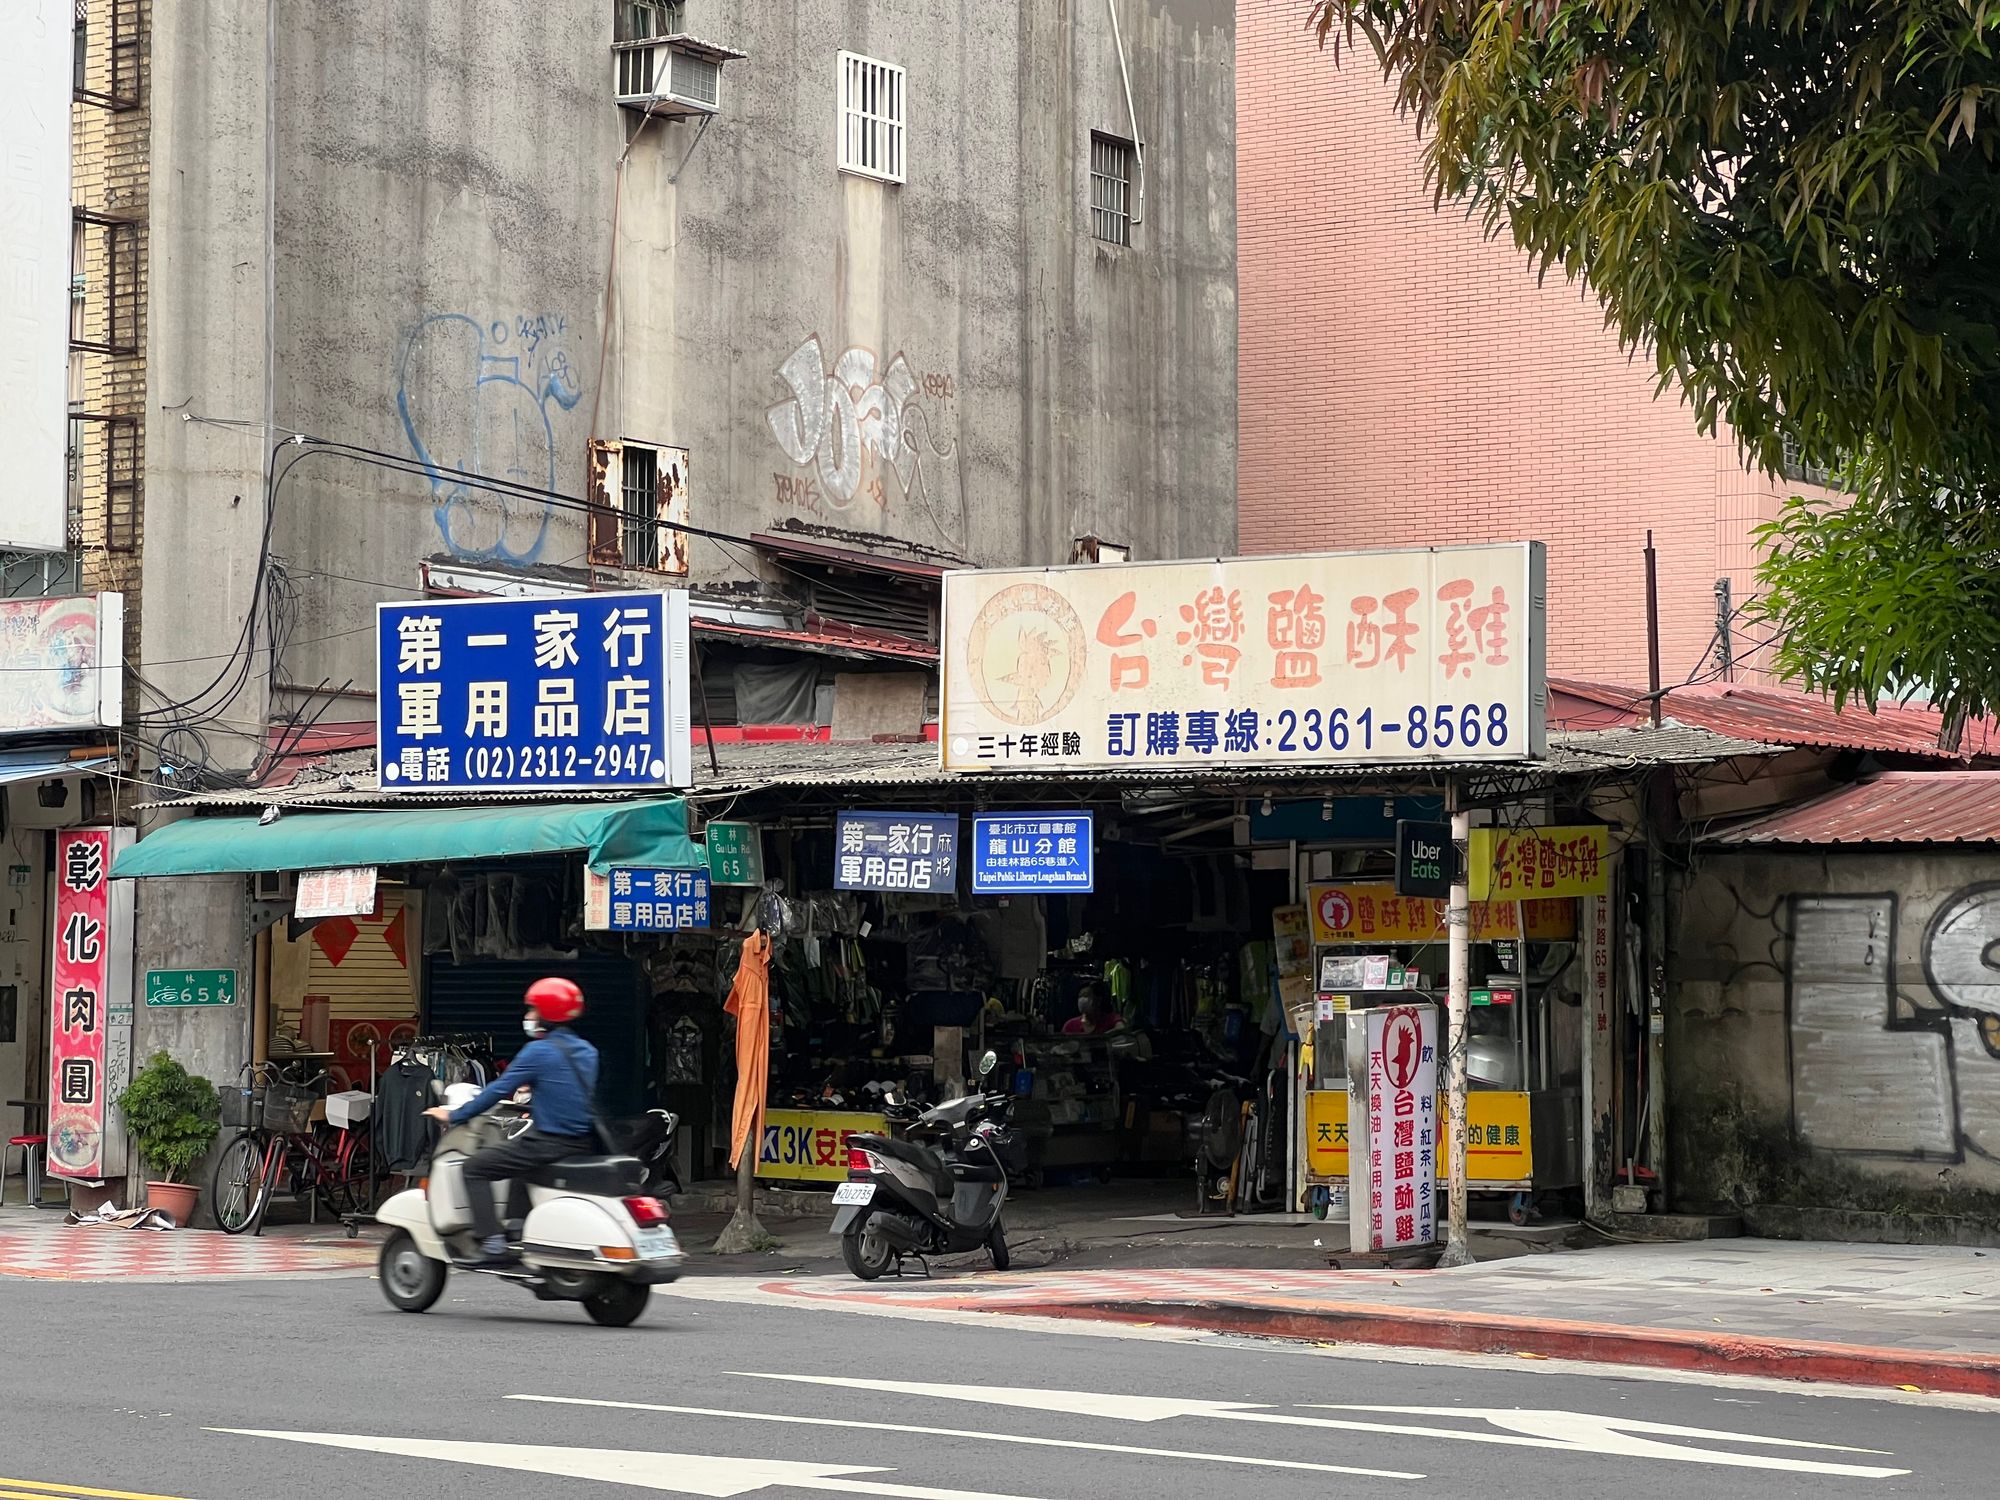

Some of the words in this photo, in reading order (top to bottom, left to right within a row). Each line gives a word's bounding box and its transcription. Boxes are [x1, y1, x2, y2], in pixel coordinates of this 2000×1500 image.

[397, 607, 650, 674] 第一家行
[1096, 579, 1510, 692] 台灣鹽酥雞
[397, 675, 650, 739] 軍用品店
[977, 731, 1081, 758] 三十年經驗
[400, 746, 449, 781] 電話
[464, 744, 651, 779] (02)2312-2947
[842, 821, 934, 854] 第一家行
[988, 823, 1077, 835] 臺北市立圖書館
[935, 833, 952, 877] 麻將
[989, 837, 1076, 855] 龍山分館
[1411, 840, 1441, 860] Uber
[840, 856, 932, 889] 軍用品店
[986, 856, 1079, 867] 由桂林路65巷進入
[1411, 860, 1440, 879] Eats
[1494, 835, 1598, 890] 台灣鹽酥雞
[613, 870, 692, 898] 第一家行
[978, 872, 996, 883] Taipei
[997, 872, 1015, 881] Public
[1016, 872, 1036, 883] Library
[1038, 871, 1065, 883] Longshan
[1066, 871, 1087, 881] Branch
[613, 902, 693, 928] 軍用品店
[694, 879, 707, 921] 麻將
[61, 842, 102, 1105] 彰化肉圓
[153, 974, 228, 986] 桂林路
